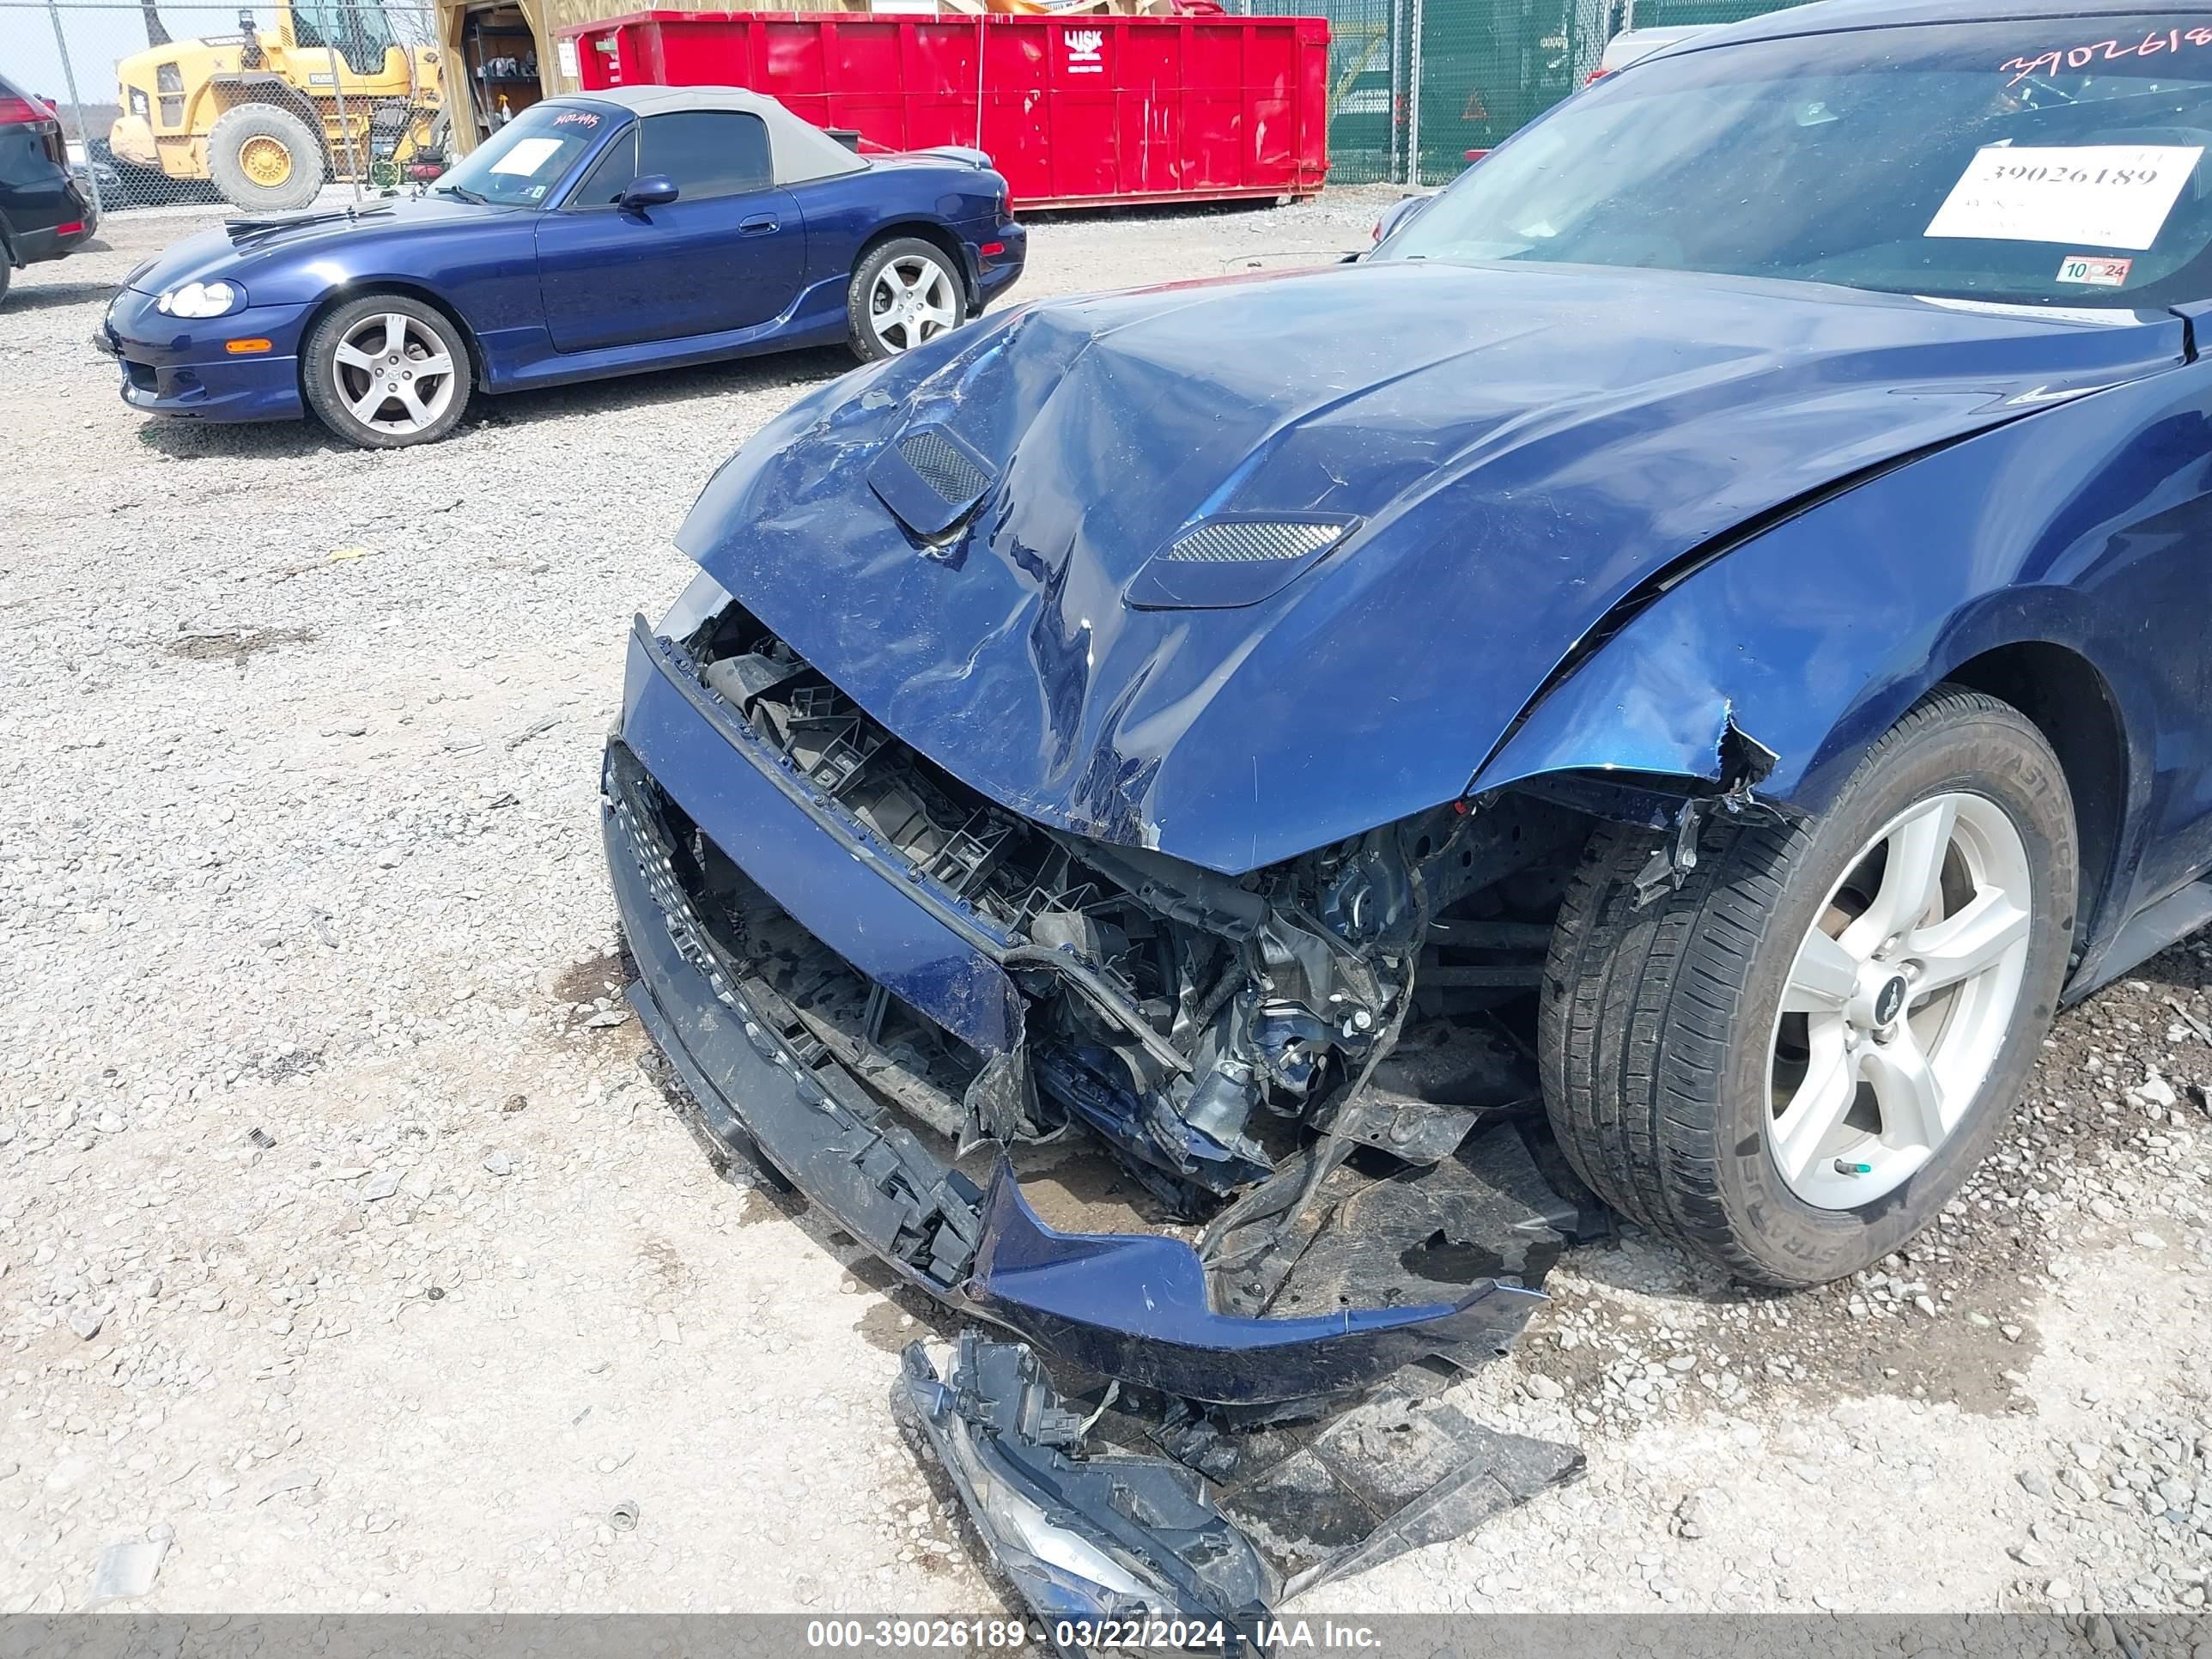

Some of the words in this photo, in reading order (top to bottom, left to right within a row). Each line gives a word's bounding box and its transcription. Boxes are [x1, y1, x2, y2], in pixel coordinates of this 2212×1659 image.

[1064, 30, 1103, 52] LUSK
[1983, 166, 2158, 185] 39026189
[2067, 263, 2087, 278] 10
[2106, 264, 2125, 277] 24
